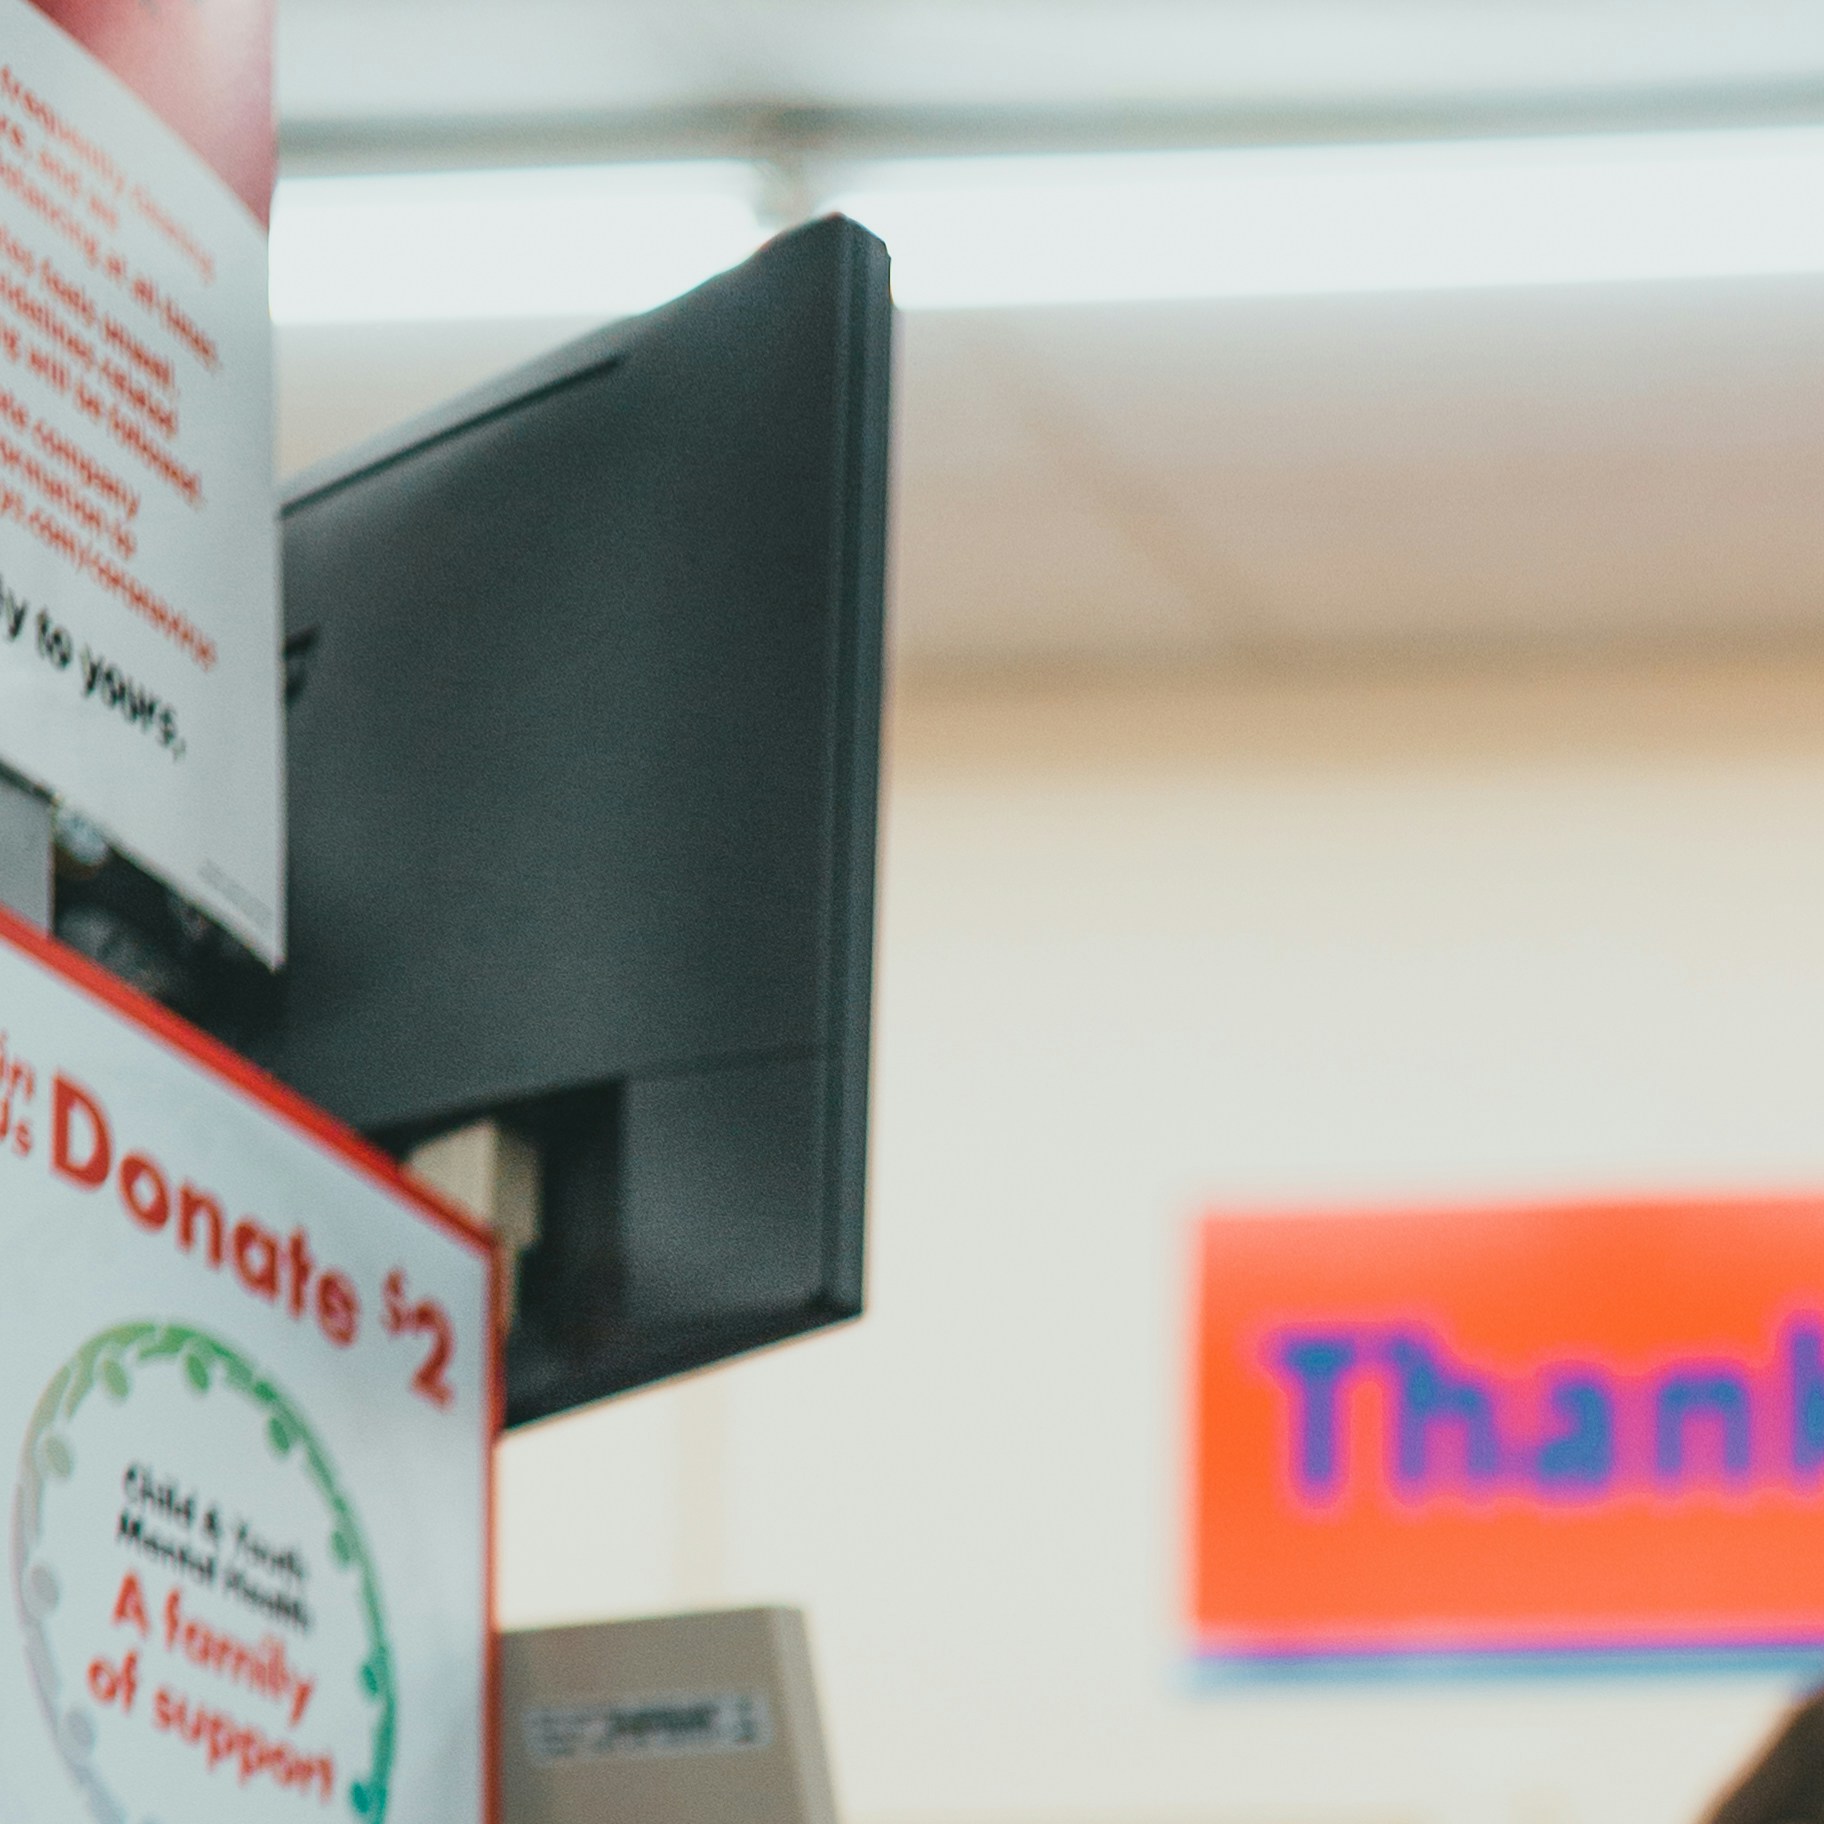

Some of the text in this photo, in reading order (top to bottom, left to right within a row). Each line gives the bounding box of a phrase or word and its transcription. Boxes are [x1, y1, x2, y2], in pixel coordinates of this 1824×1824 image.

[51, 1069, 359, 1349] Donate
[112, 1568, 150, 1638] A
[87, 1643, 138, 1715] of
